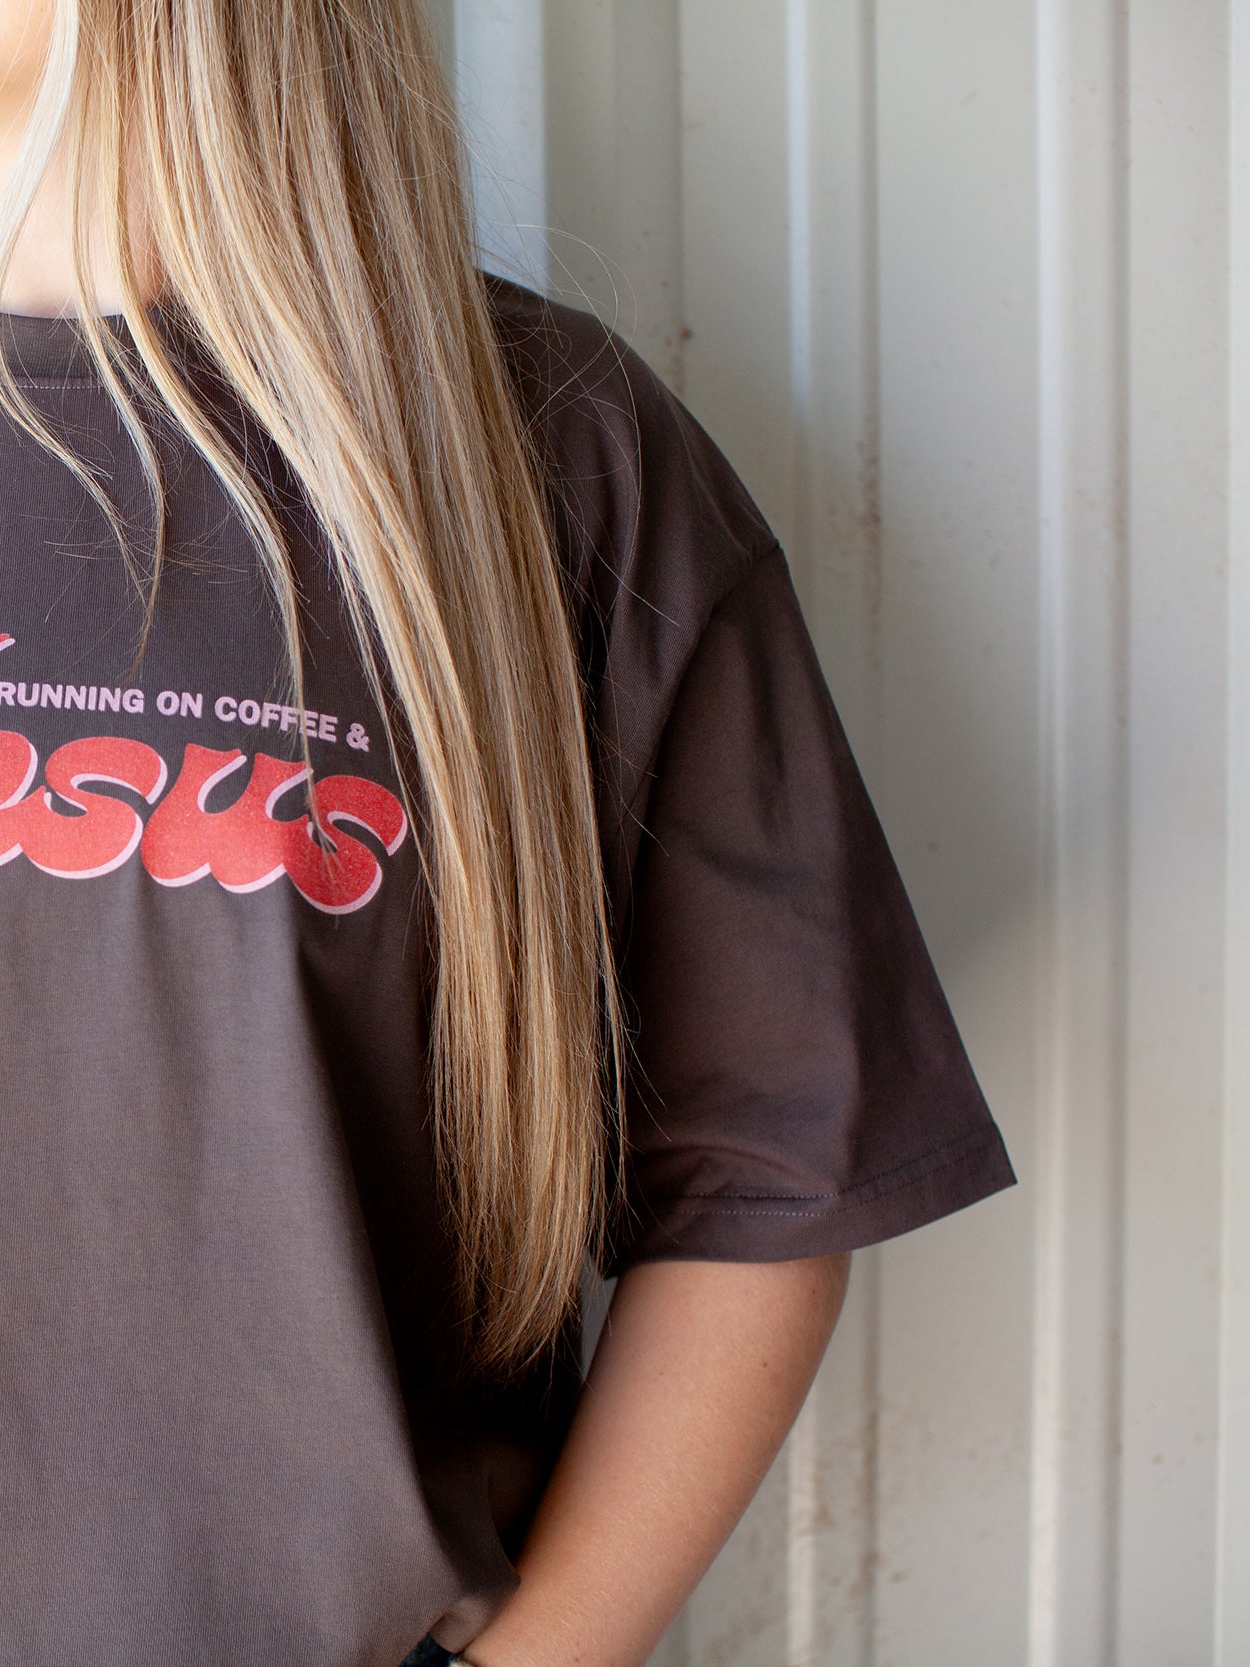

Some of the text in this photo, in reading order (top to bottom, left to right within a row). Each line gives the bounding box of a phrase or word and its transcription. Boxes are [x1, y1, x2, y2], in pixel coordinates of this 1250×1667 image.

[156, 690, 203, 719] ON
[213, 696, 338, 743] COFFEE
[345, 722, 370, 752] &
